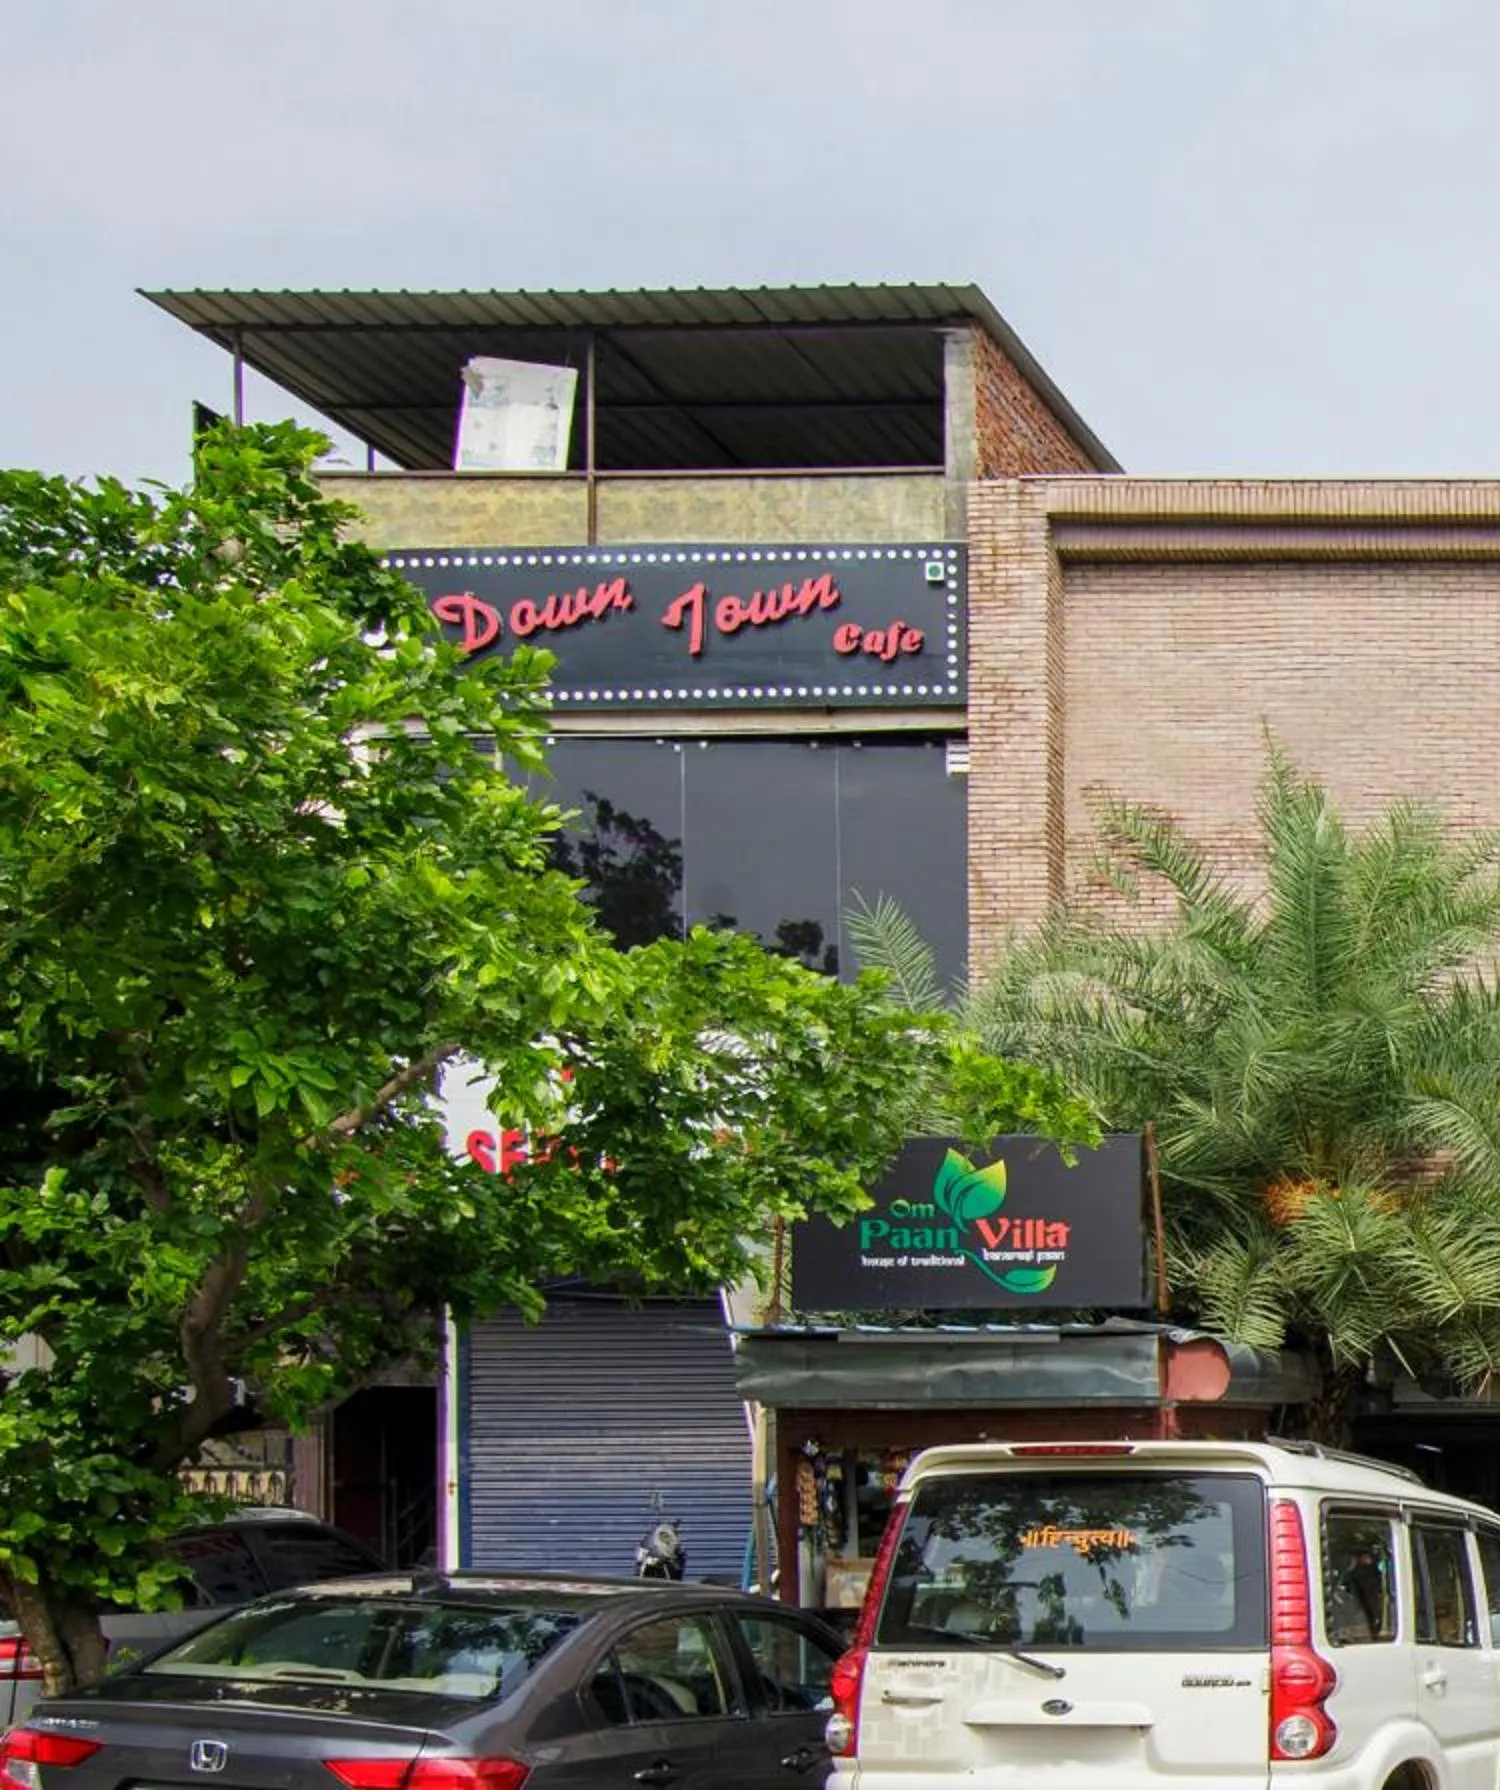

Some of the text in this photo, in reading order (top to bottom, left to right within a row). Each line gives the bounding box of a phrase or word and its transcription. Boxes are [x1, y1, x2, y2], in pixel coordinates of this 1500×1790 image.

[433, 573, 840, 656] Down Town
[832, 622, 924, 662] Cafe
[889, 1199, 935, 1218] Om
[860, 1217, 1071, 1249] Paan Villa
